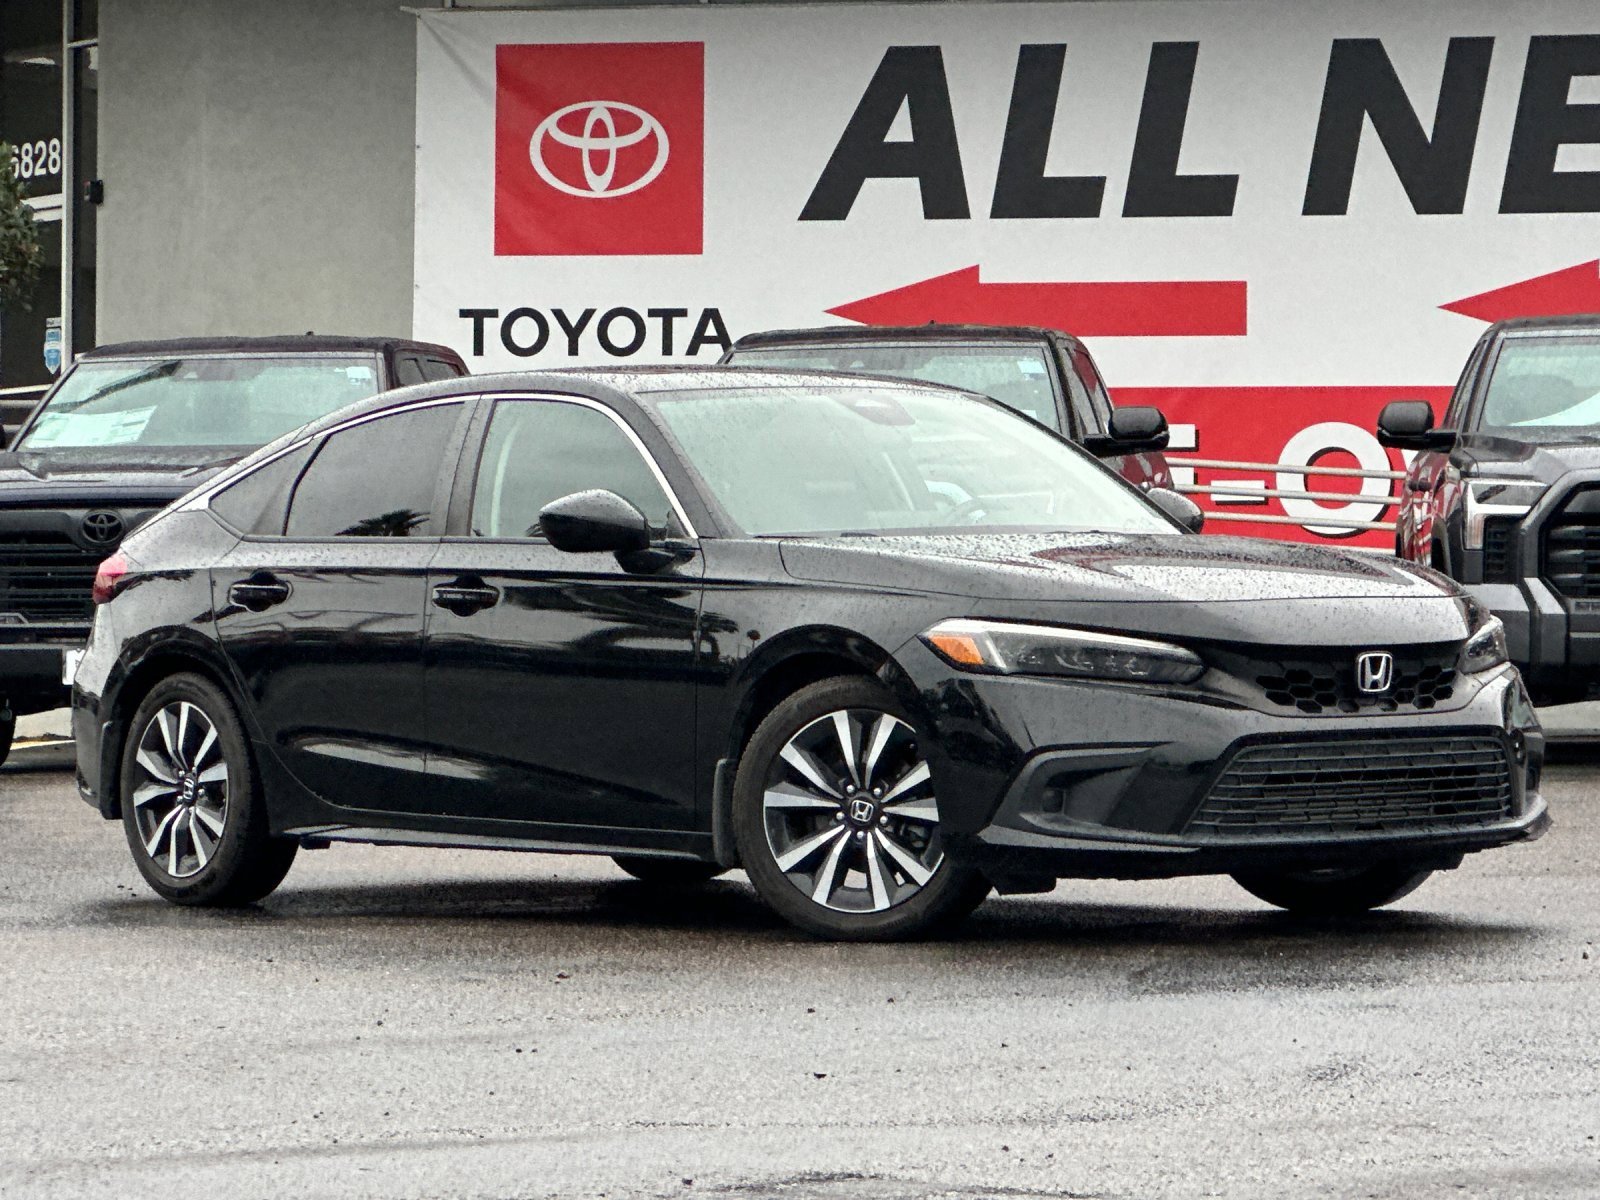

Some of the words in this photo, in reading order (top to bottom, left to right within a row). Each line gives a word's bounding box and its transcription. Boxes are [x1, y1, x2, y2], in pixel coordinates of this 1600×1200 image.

[798, 41, 1240, 220] ALL
[1301, 34, 1600, 216] NE
[459, 307, 733, 357] TOYOTA
